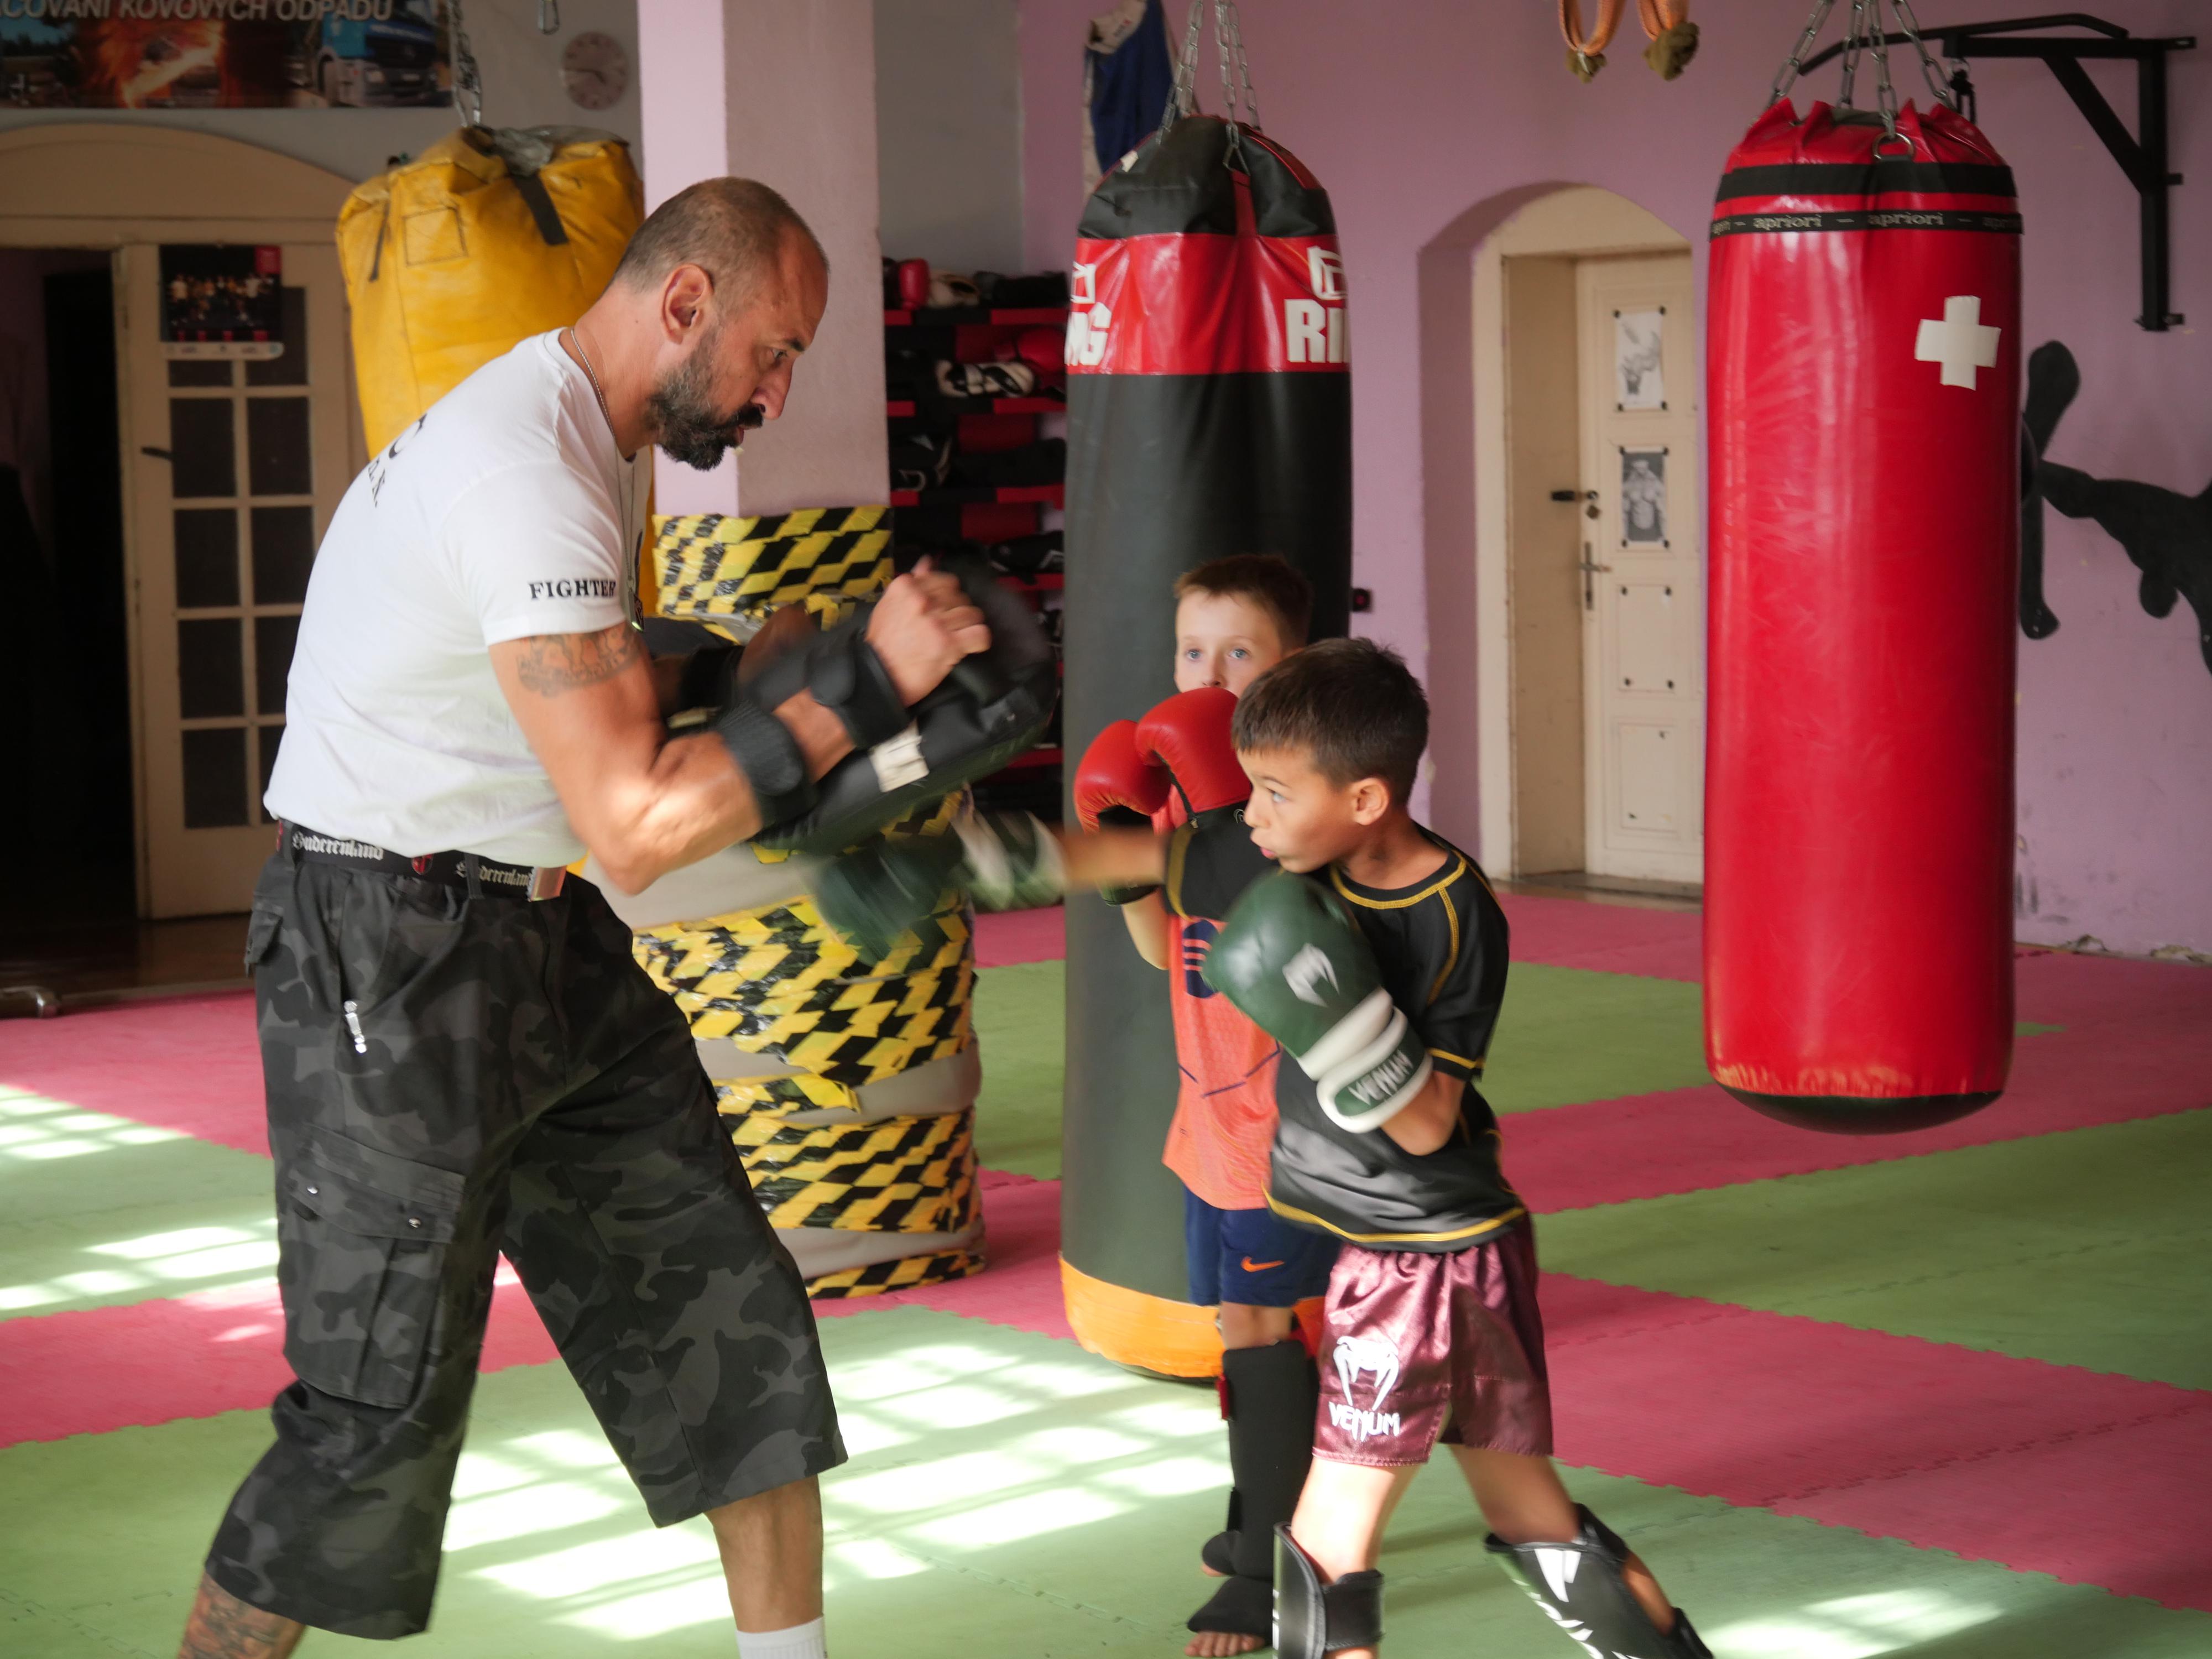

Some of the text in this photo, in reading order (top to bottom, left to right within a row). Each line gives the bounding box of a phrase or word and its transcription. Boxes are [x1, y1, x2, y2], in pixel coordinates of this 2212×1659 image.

[1753, 211, 1944, 231] apriori apriori
[1284, 299, 1352, 363] RI
[527, 578, 617, 601] FIGHTER
[1328, 1401, 1400, 1442] VENUM
